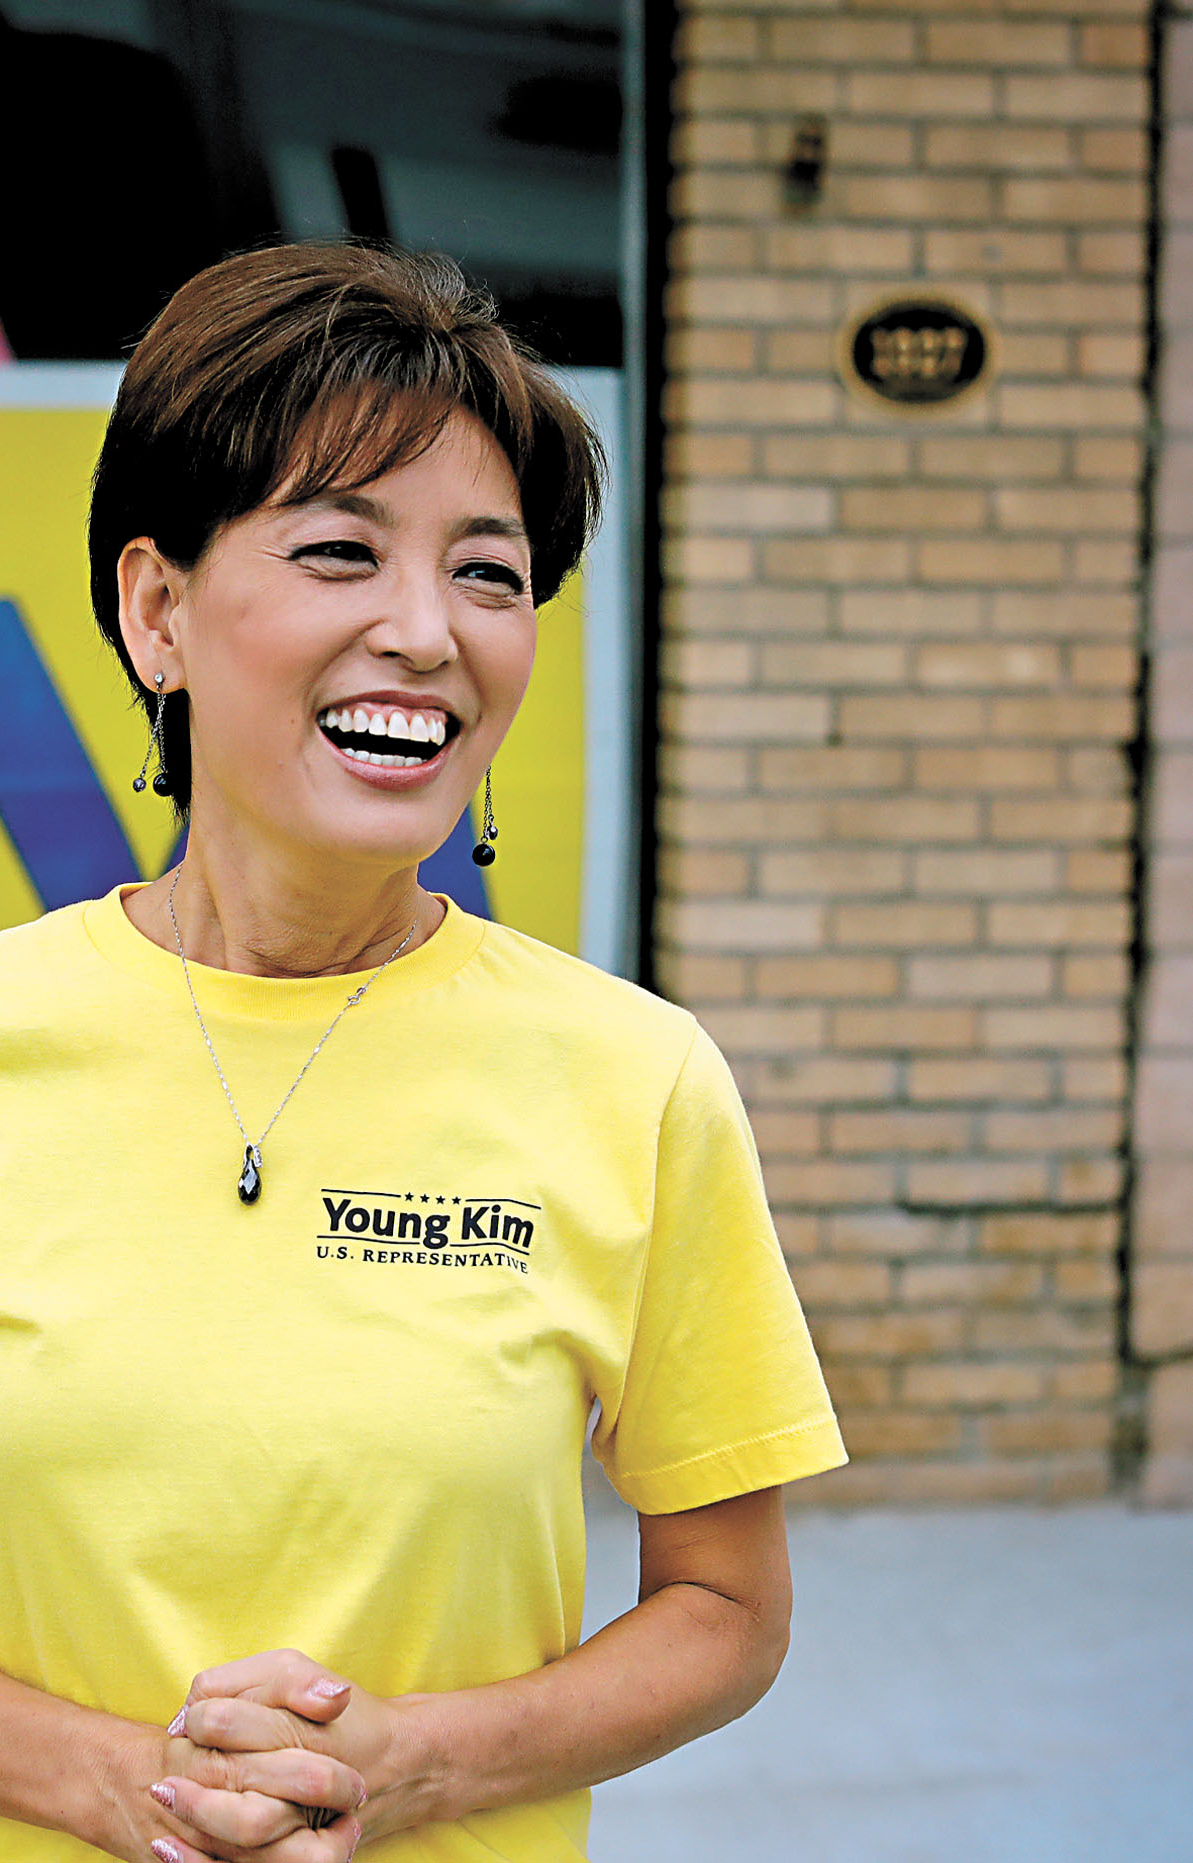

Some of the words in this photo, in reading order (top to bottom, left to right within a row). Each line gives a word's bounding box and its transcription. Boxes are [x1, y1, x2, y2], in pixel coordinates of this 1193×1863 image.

[322, 1197, 450, 1249] Young
[460, 1204, 535, 1249] Kim
[316, 1246, 354, 1260] U.S.
[362, 1249, 529, 1275] REPRESENTATIVE
